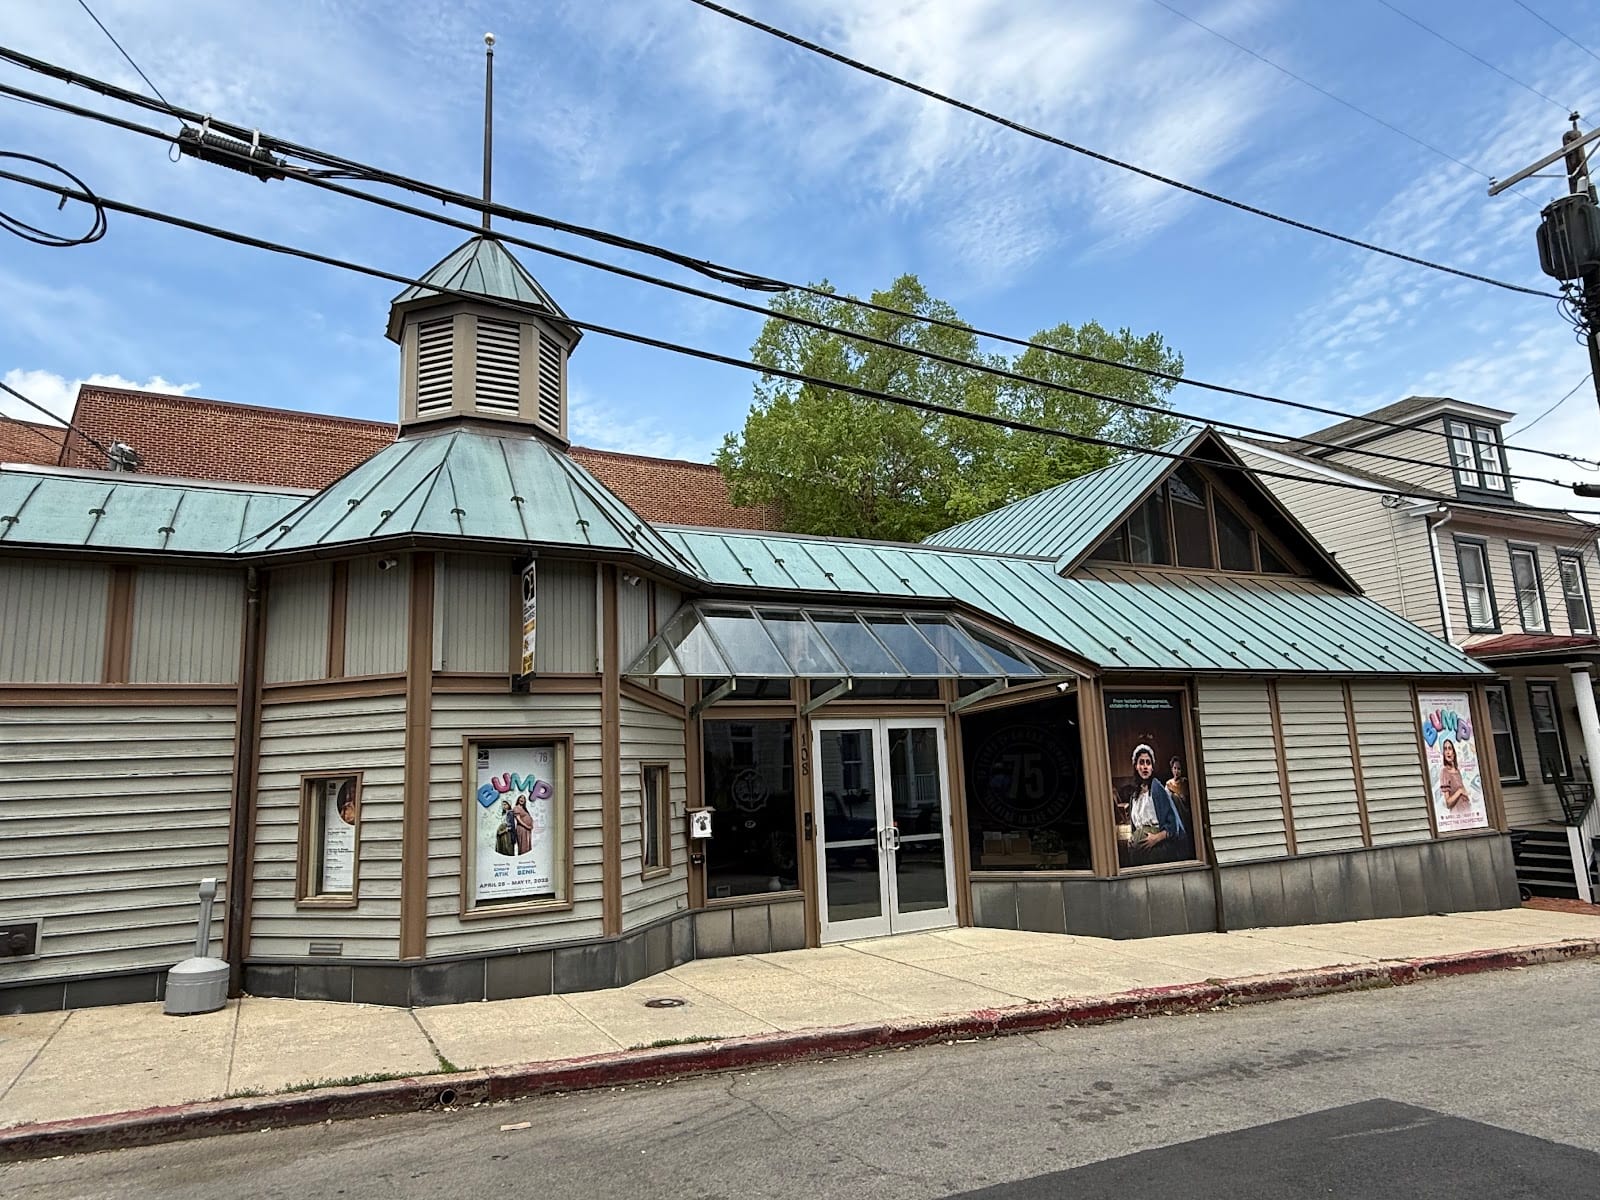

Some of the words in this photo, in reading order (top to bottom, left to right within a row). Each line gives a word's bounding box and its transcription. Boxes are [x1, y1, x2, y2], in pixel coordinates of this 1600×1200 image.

[1423, 709, 1471, 748] BUMP
[801, 733, 809, 776] 108
[477, 772, 554, 808] BUMP
